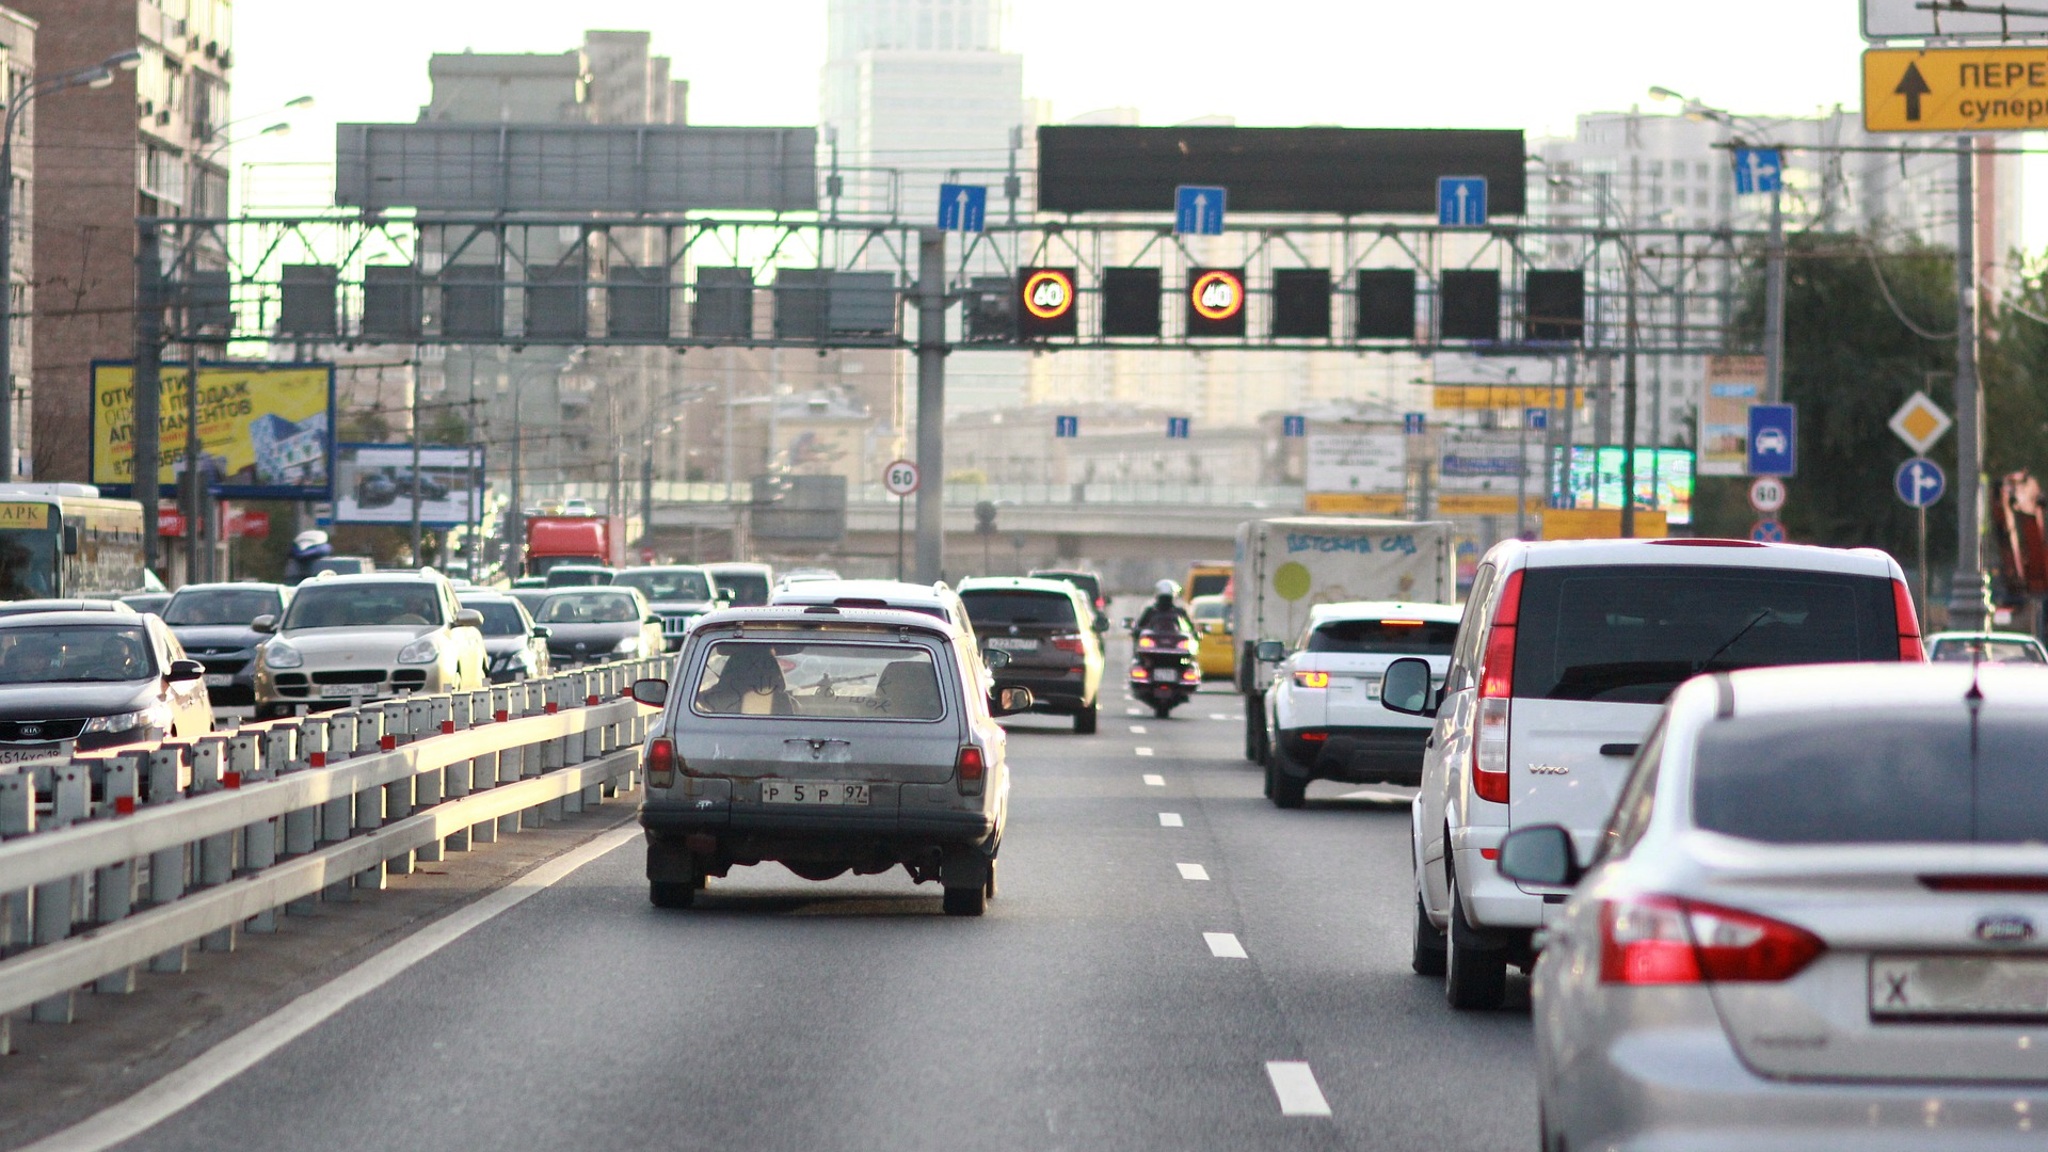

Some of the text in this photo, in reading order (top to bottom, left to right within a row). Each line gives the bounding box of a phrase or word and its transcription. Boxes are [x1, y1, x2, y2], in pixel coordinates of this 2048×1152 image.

[1960, 62, 2047, 88] ПЕРЕ
[1959, 98, 2048, 122] супер
[109, 398, 253, 444] АПТАМЕНТОВ
[892, 470, 913, 485] 60
[1757, 486, 1777, 502] 60
[845, 786, 863, 799] 97
